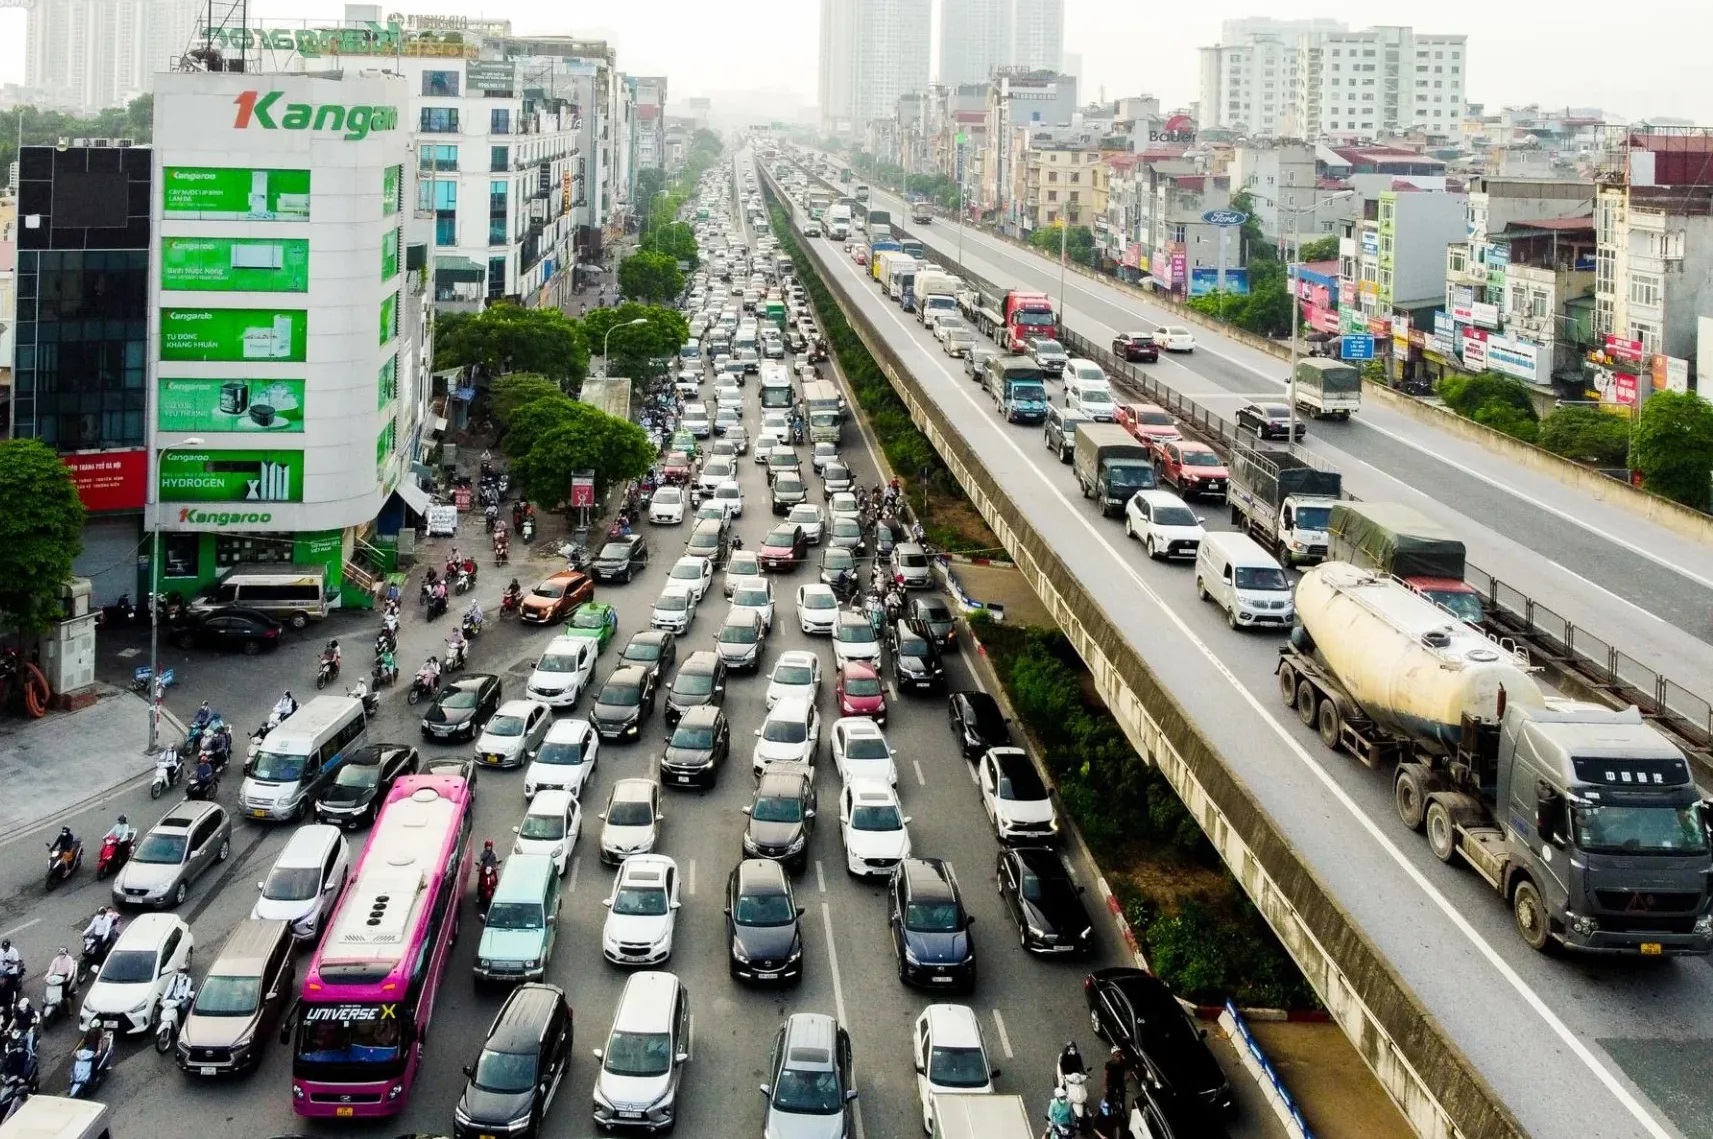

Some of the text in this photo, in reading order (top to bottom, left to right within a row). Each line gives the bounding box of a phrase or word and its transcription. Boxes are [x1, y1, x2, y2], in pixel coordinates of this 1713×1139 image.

[1211, 212, 1238, 223] Ford
[162, 478, 225, 488] HYDROGEN
[179, 507, 272, 526] Kangaroo
[306, 1004, 396, 1020] UNIVERSE X
